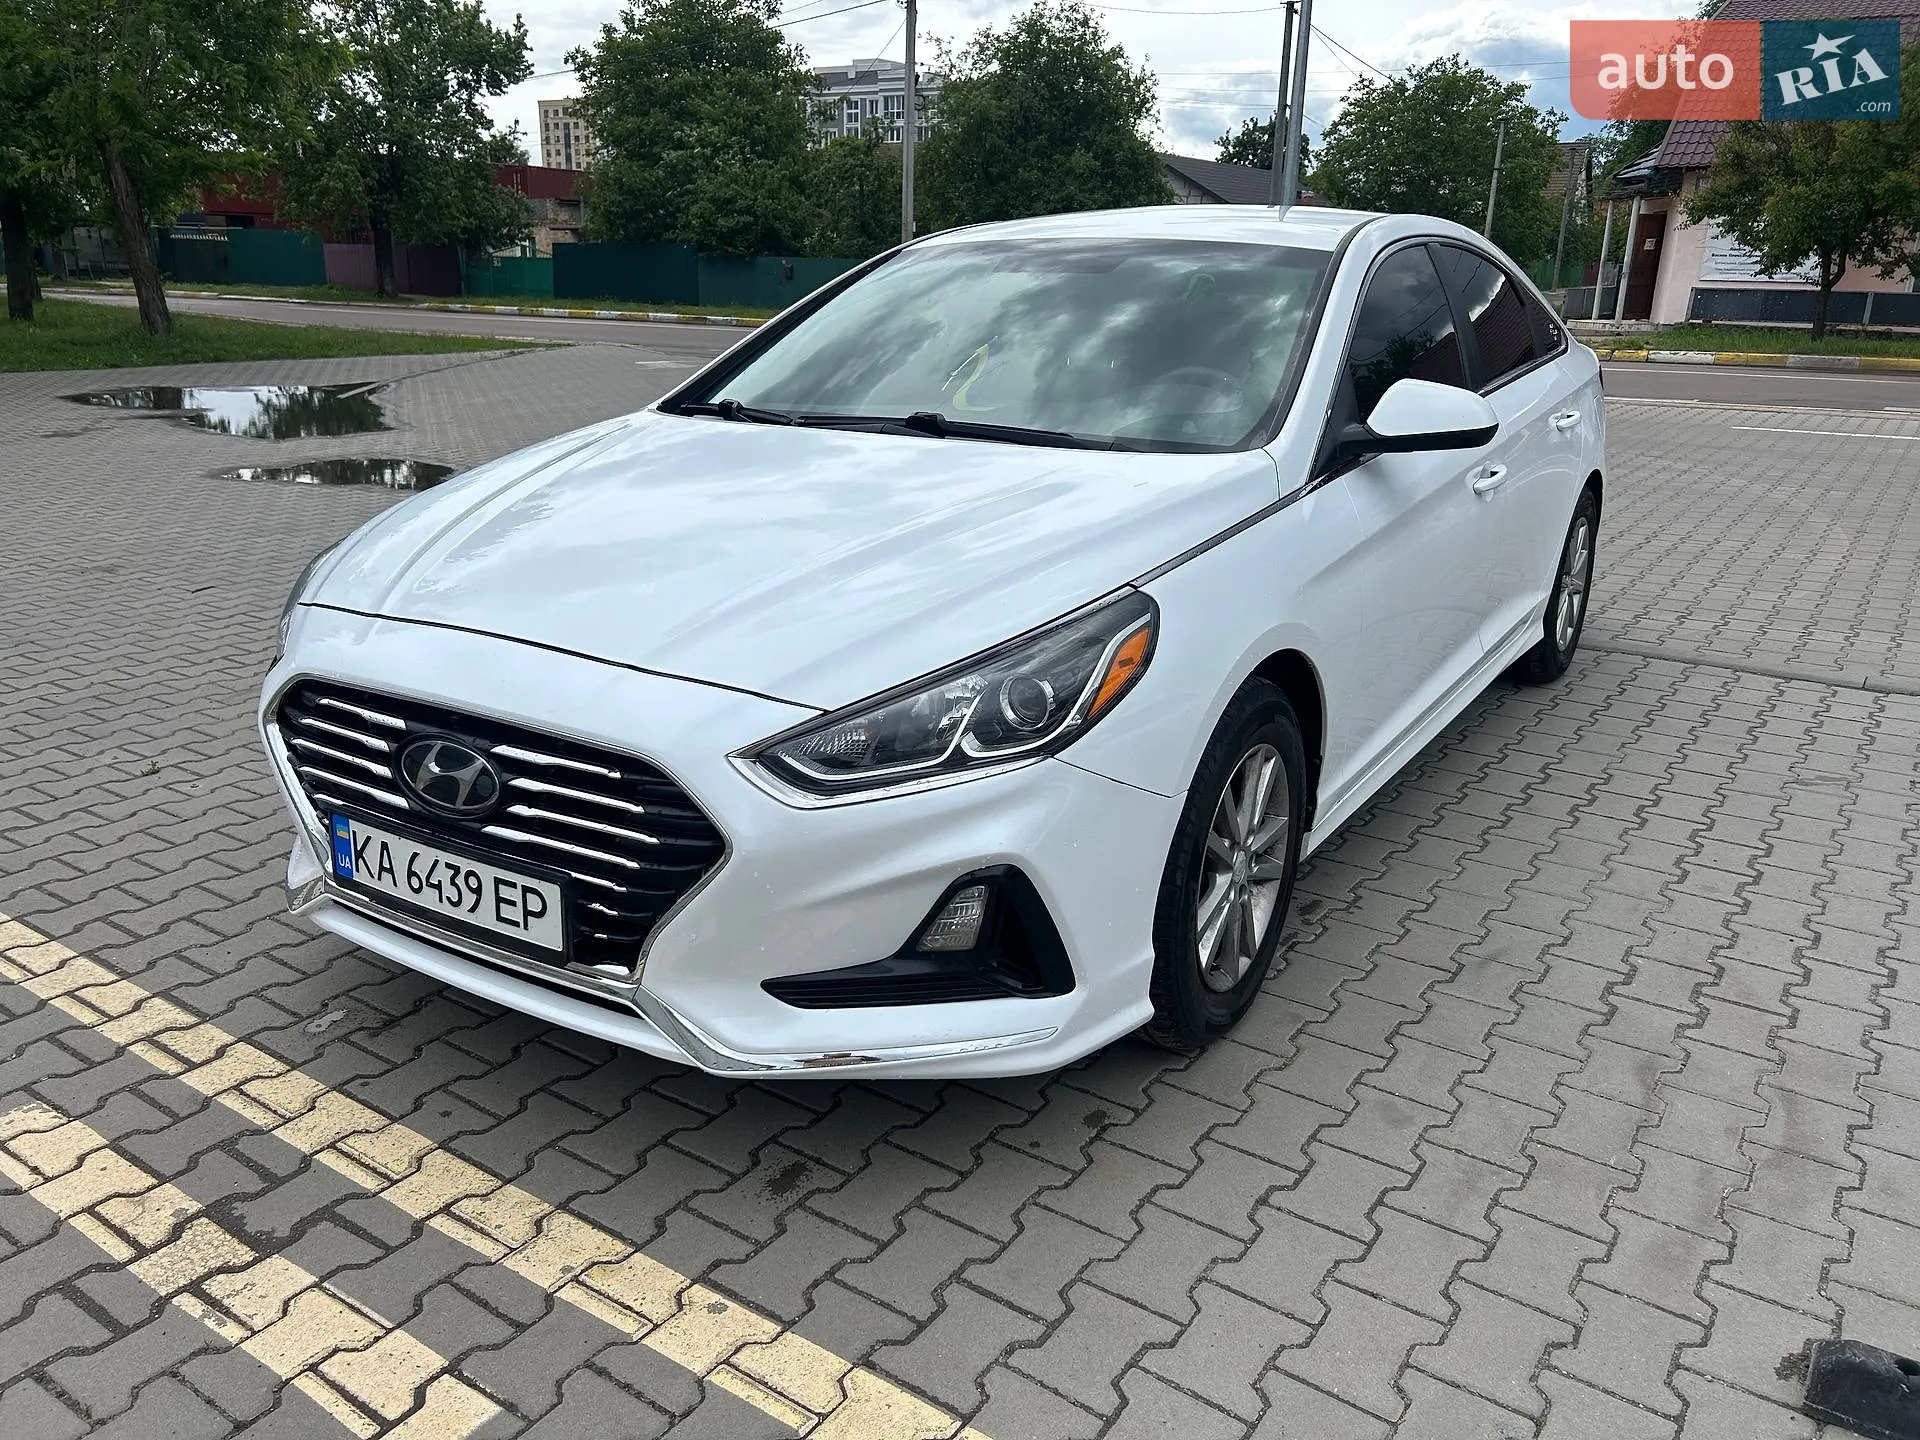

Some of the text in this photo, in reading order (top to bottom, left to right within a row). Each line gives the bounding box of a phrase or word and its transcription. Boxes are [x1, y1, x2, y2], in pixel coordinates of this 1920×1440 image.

[338, 853, 351, 869] UA
[352, 829, 548, 931] KA 6439 EP
